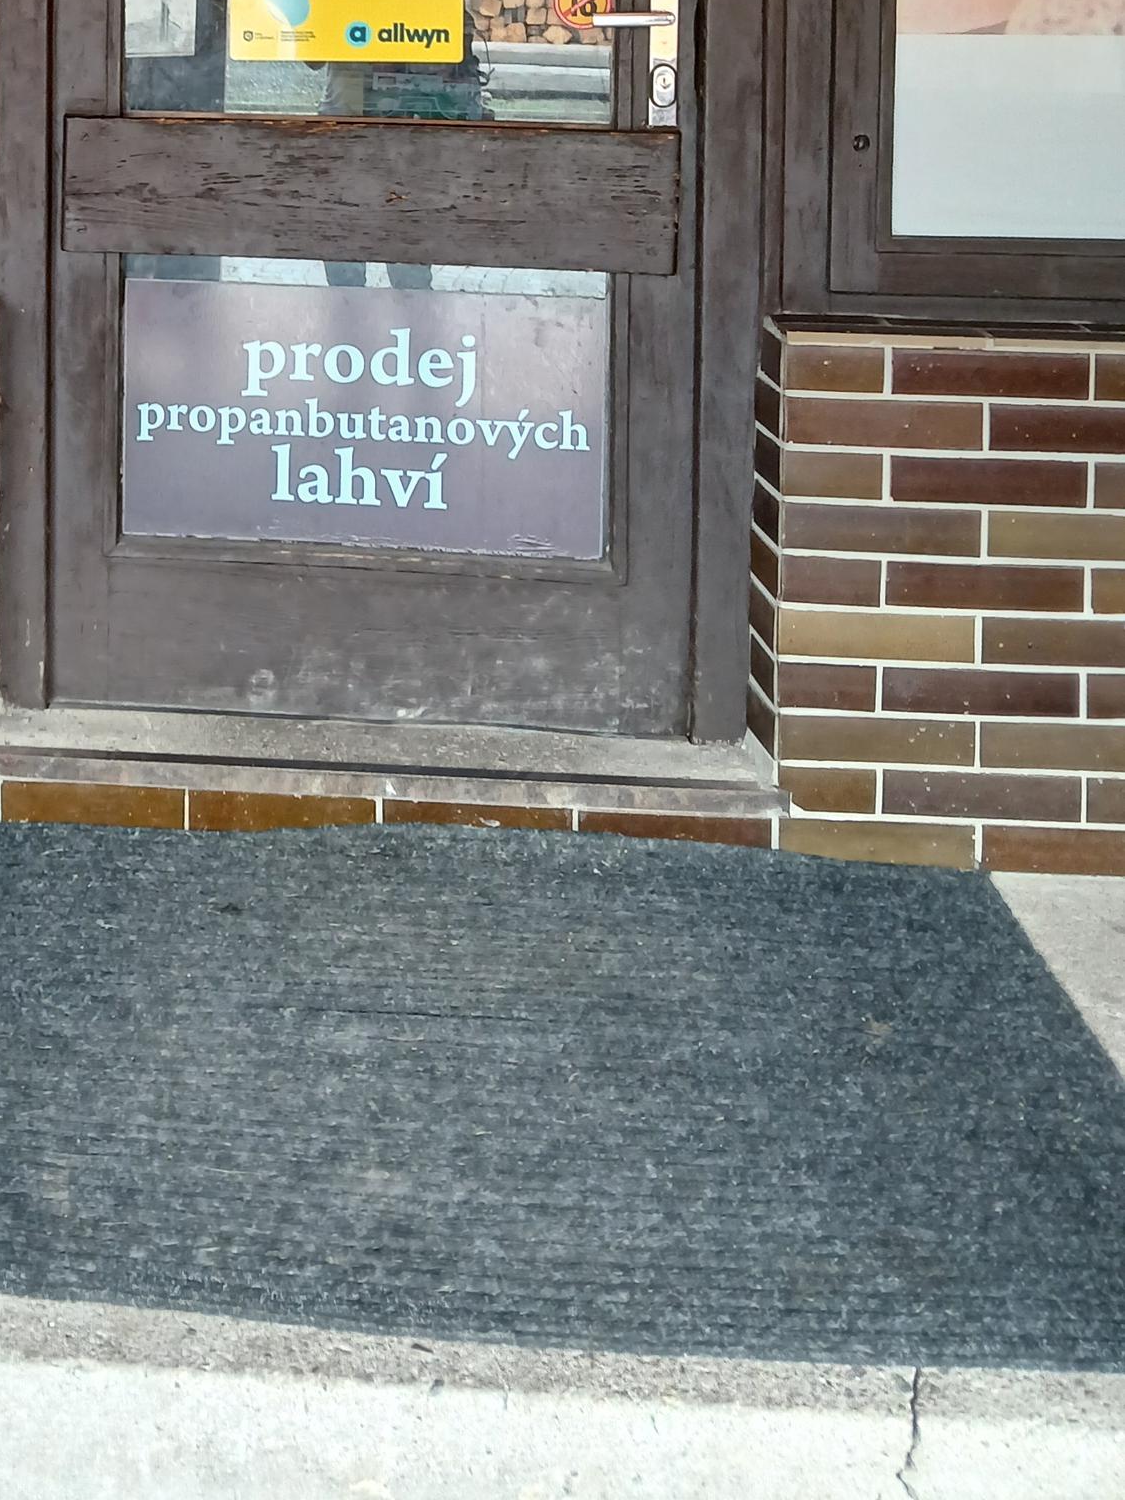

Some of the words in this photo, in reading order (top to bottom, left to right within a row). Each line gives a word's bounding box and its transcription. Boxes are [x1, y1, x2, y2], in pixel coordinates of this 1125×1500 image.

[378, 23, 450, 48] allwyn
[241, 327, 477, 408] prodej
[136, 398, 591, 460] propanbutanových
[271, 443, 449, 511] lahví
